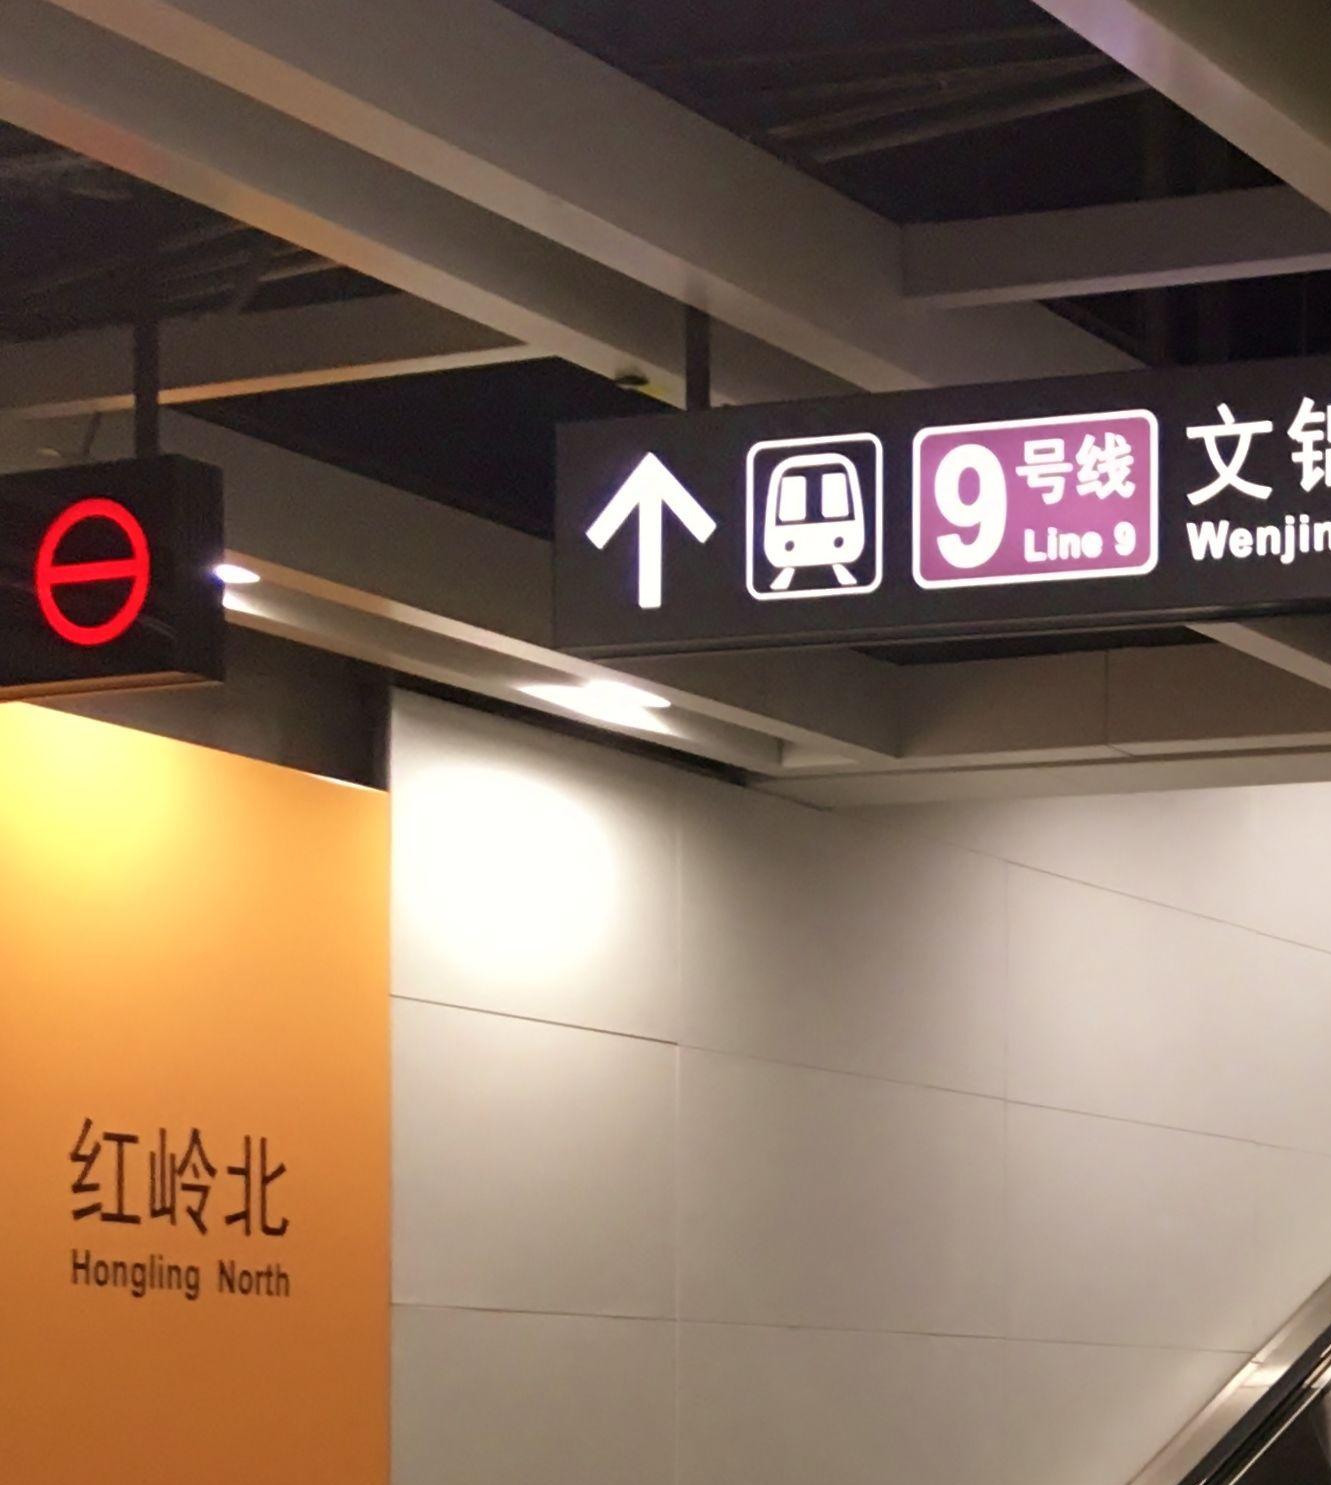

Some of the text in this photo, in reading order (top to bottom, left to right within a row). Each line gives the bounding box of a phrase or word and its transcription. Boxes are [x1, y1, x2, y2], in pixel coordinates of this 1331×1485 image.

[934, 433, 1137, 569] 9 号线
[1023, 522, 1137, 564] Line 9
[69, 1117, 290, 1237] 红岭北
[70, 1248, 291, 1300] Hongling North
